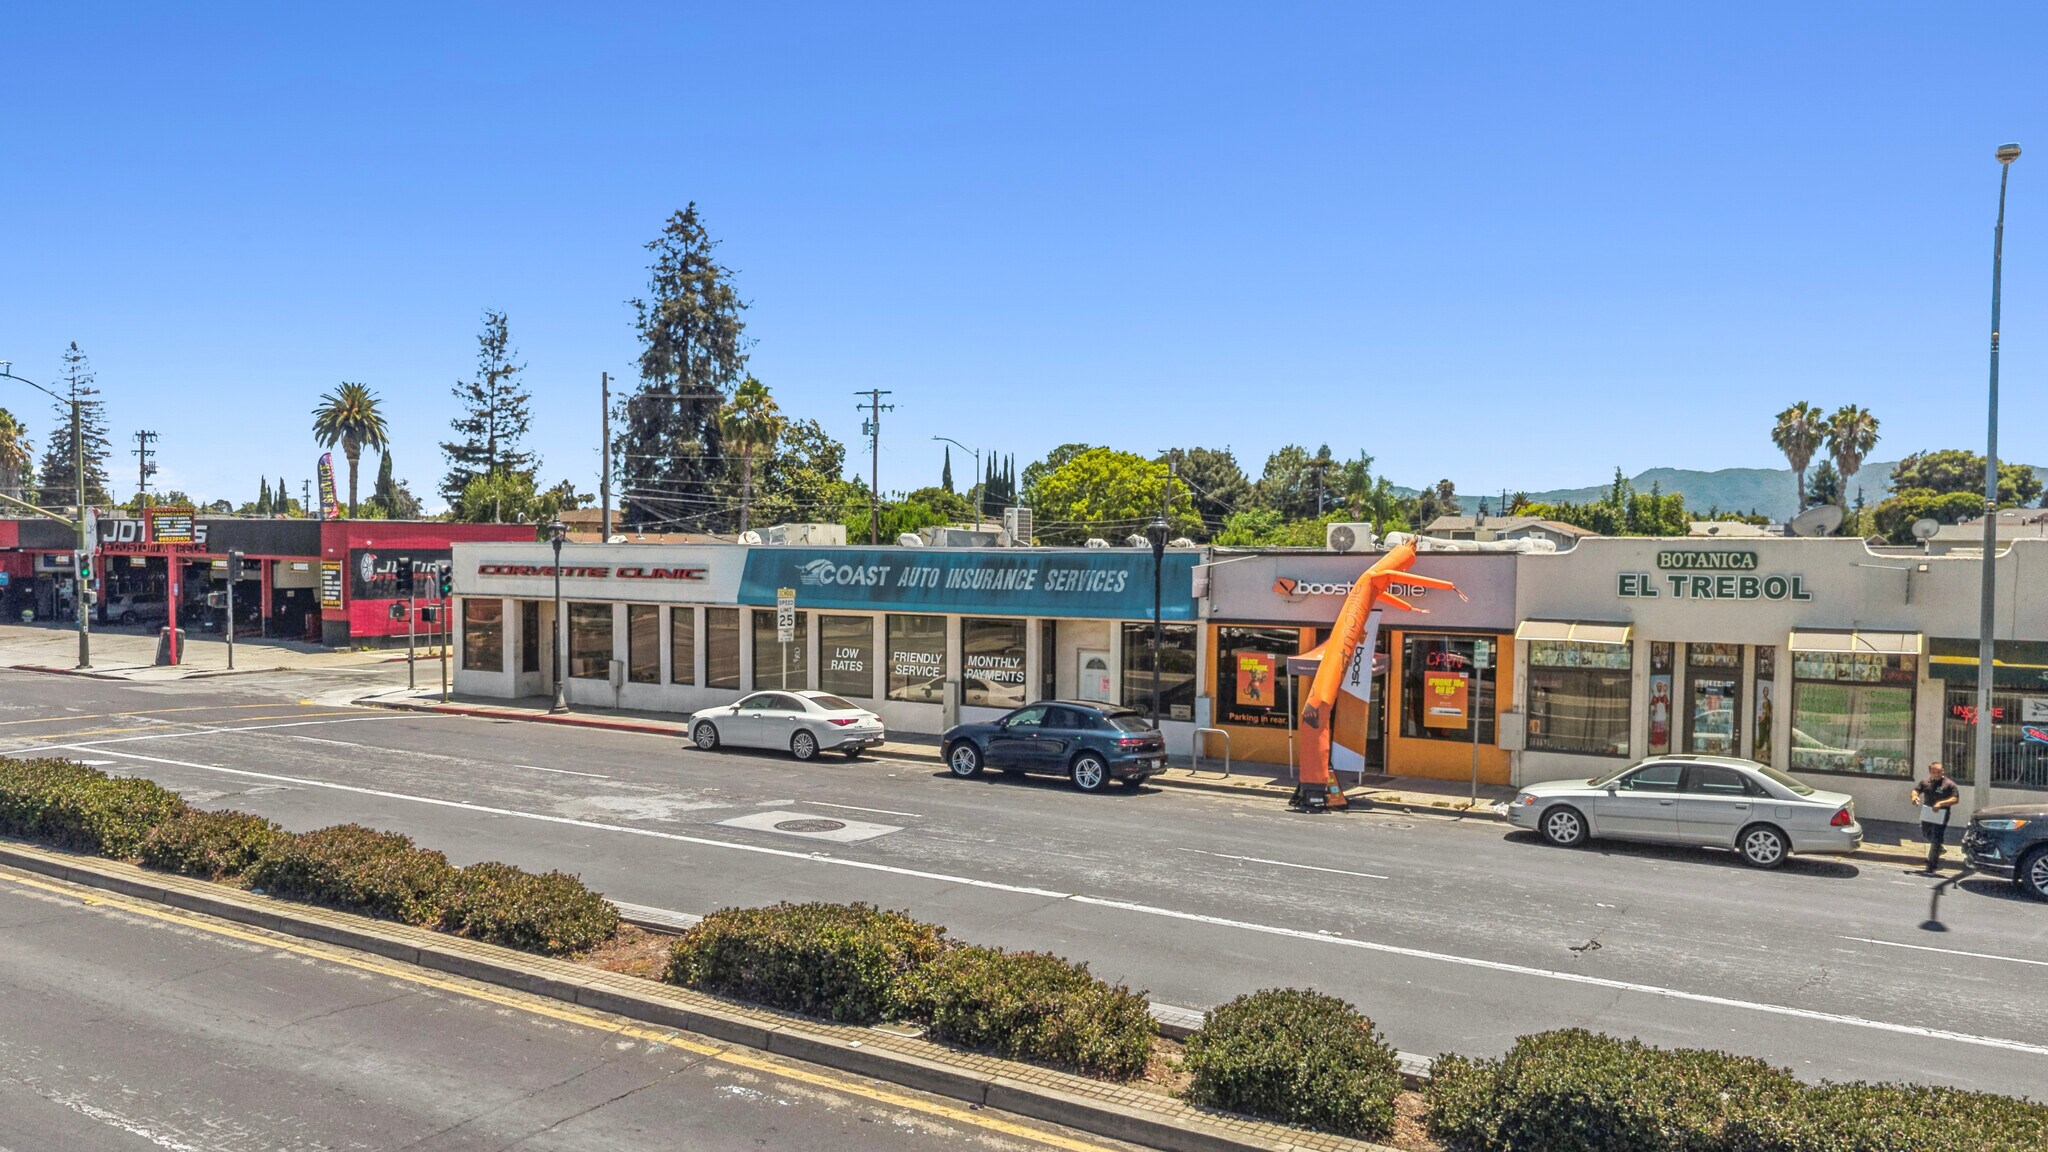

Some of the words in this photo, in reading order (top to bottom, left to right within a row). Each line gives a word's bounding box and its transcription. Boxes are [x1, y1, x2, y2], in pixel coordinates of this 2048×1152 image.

[320, 464, 334, 503] SERVICE
[1659, 552, 1755, 568] BOTANICA
[478, 564, 610, 578] CORVETTE
[616, 567, 707, 580] CLINIC
[820, 564, 890, 586] COAST
[897, 566, 940, 587] AUTO
[945, 568, 1038, 590] INSURANCE
[1044, 569, 1128, 592] SERVICES
[1298, 580, 1354, 595] boost
[1617, 573, 1659, 598] EL
[1667, 574, 1812, 601] TREBOL
[779, 614, 793, 627] 25
[836, 648, 859, 659] LOW
[894, 652, 942, 664] FRIENDLY
[1427, 652, 1464, 668] OPEN
[831, 660, 863, 671] RATES
[968, 655, 1020, 668] MONTHLY
[1351, 646, 1364, 686] boost
[895, 665, 939, 677] SERVICE
[966, 669, 1024, 682] PAYMENTS
[1229, 712, 1259, 723] Parking
[1270, 717, 1287, 725] rear.
[1961, 715, 1979, 725] TA
